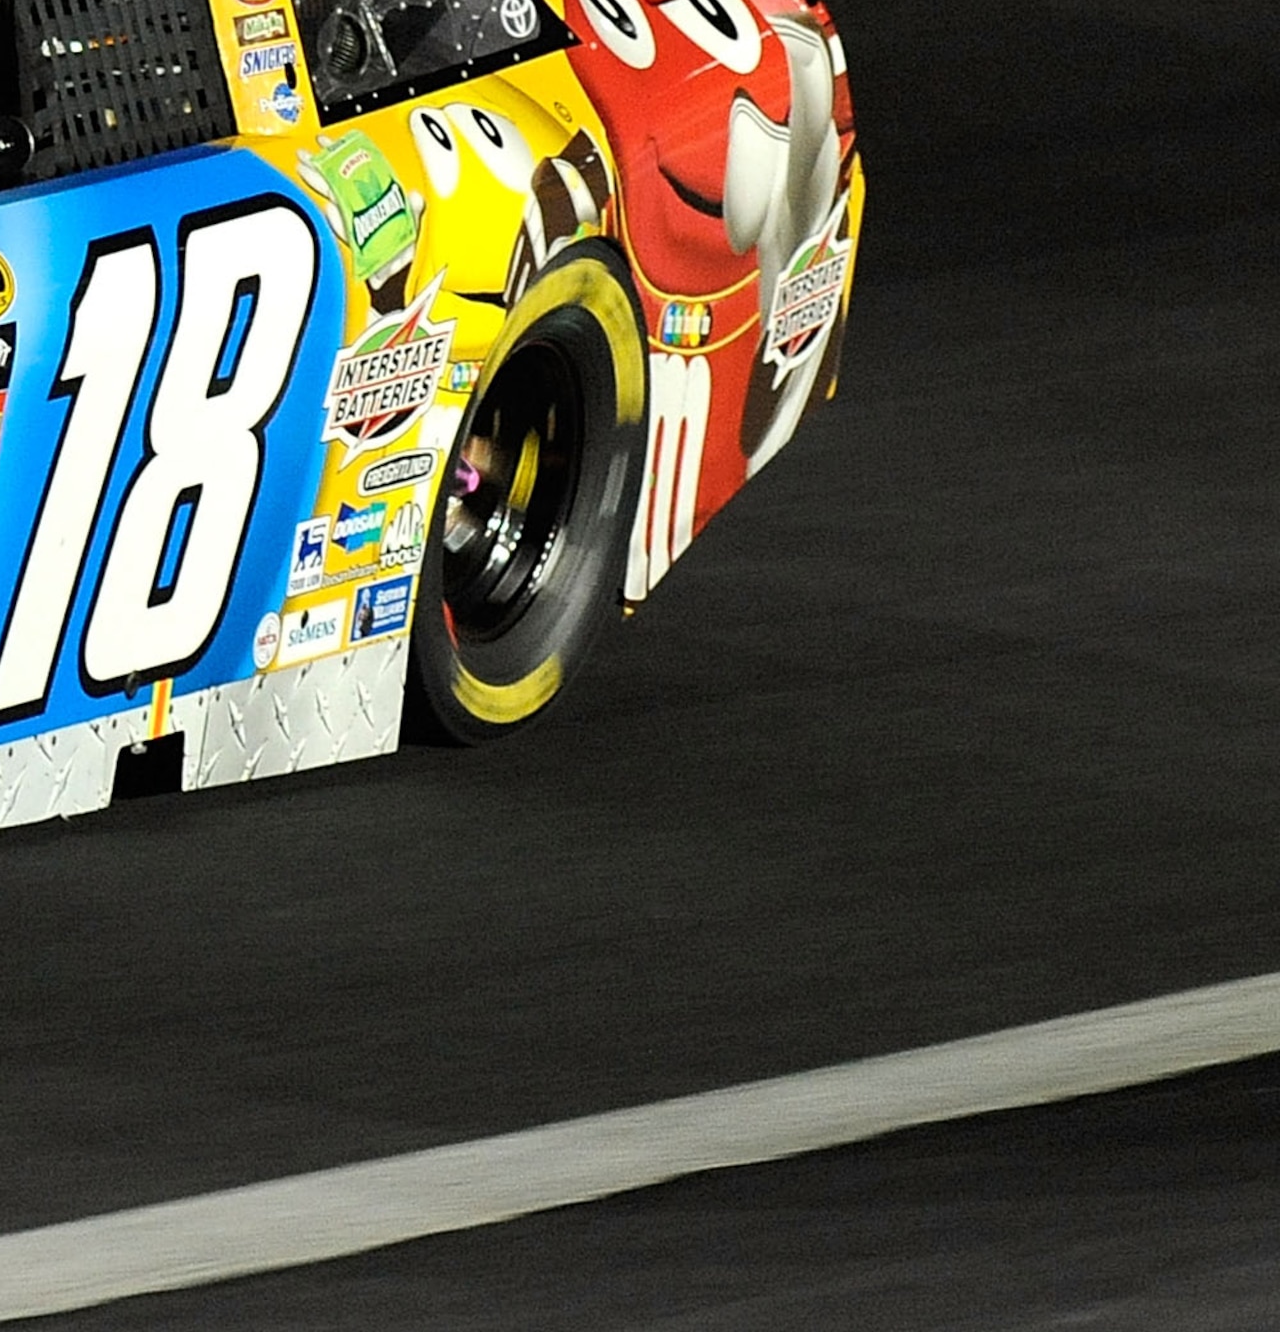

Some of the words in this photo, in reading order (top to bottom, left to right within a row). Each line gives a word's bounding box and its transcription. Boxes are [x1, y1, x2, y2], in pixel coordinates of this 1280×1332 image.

[242, 43, 297, 75] SNICKERS
[334, 338, 445, 390] INTERSTATE
[334, 374, 433, 422] BATTERIES
[333, 510, 386, 540] DOOSAN
[379, 545, 421, 570] TOOLS
[288, 617, 337, 647] SIEMENS
